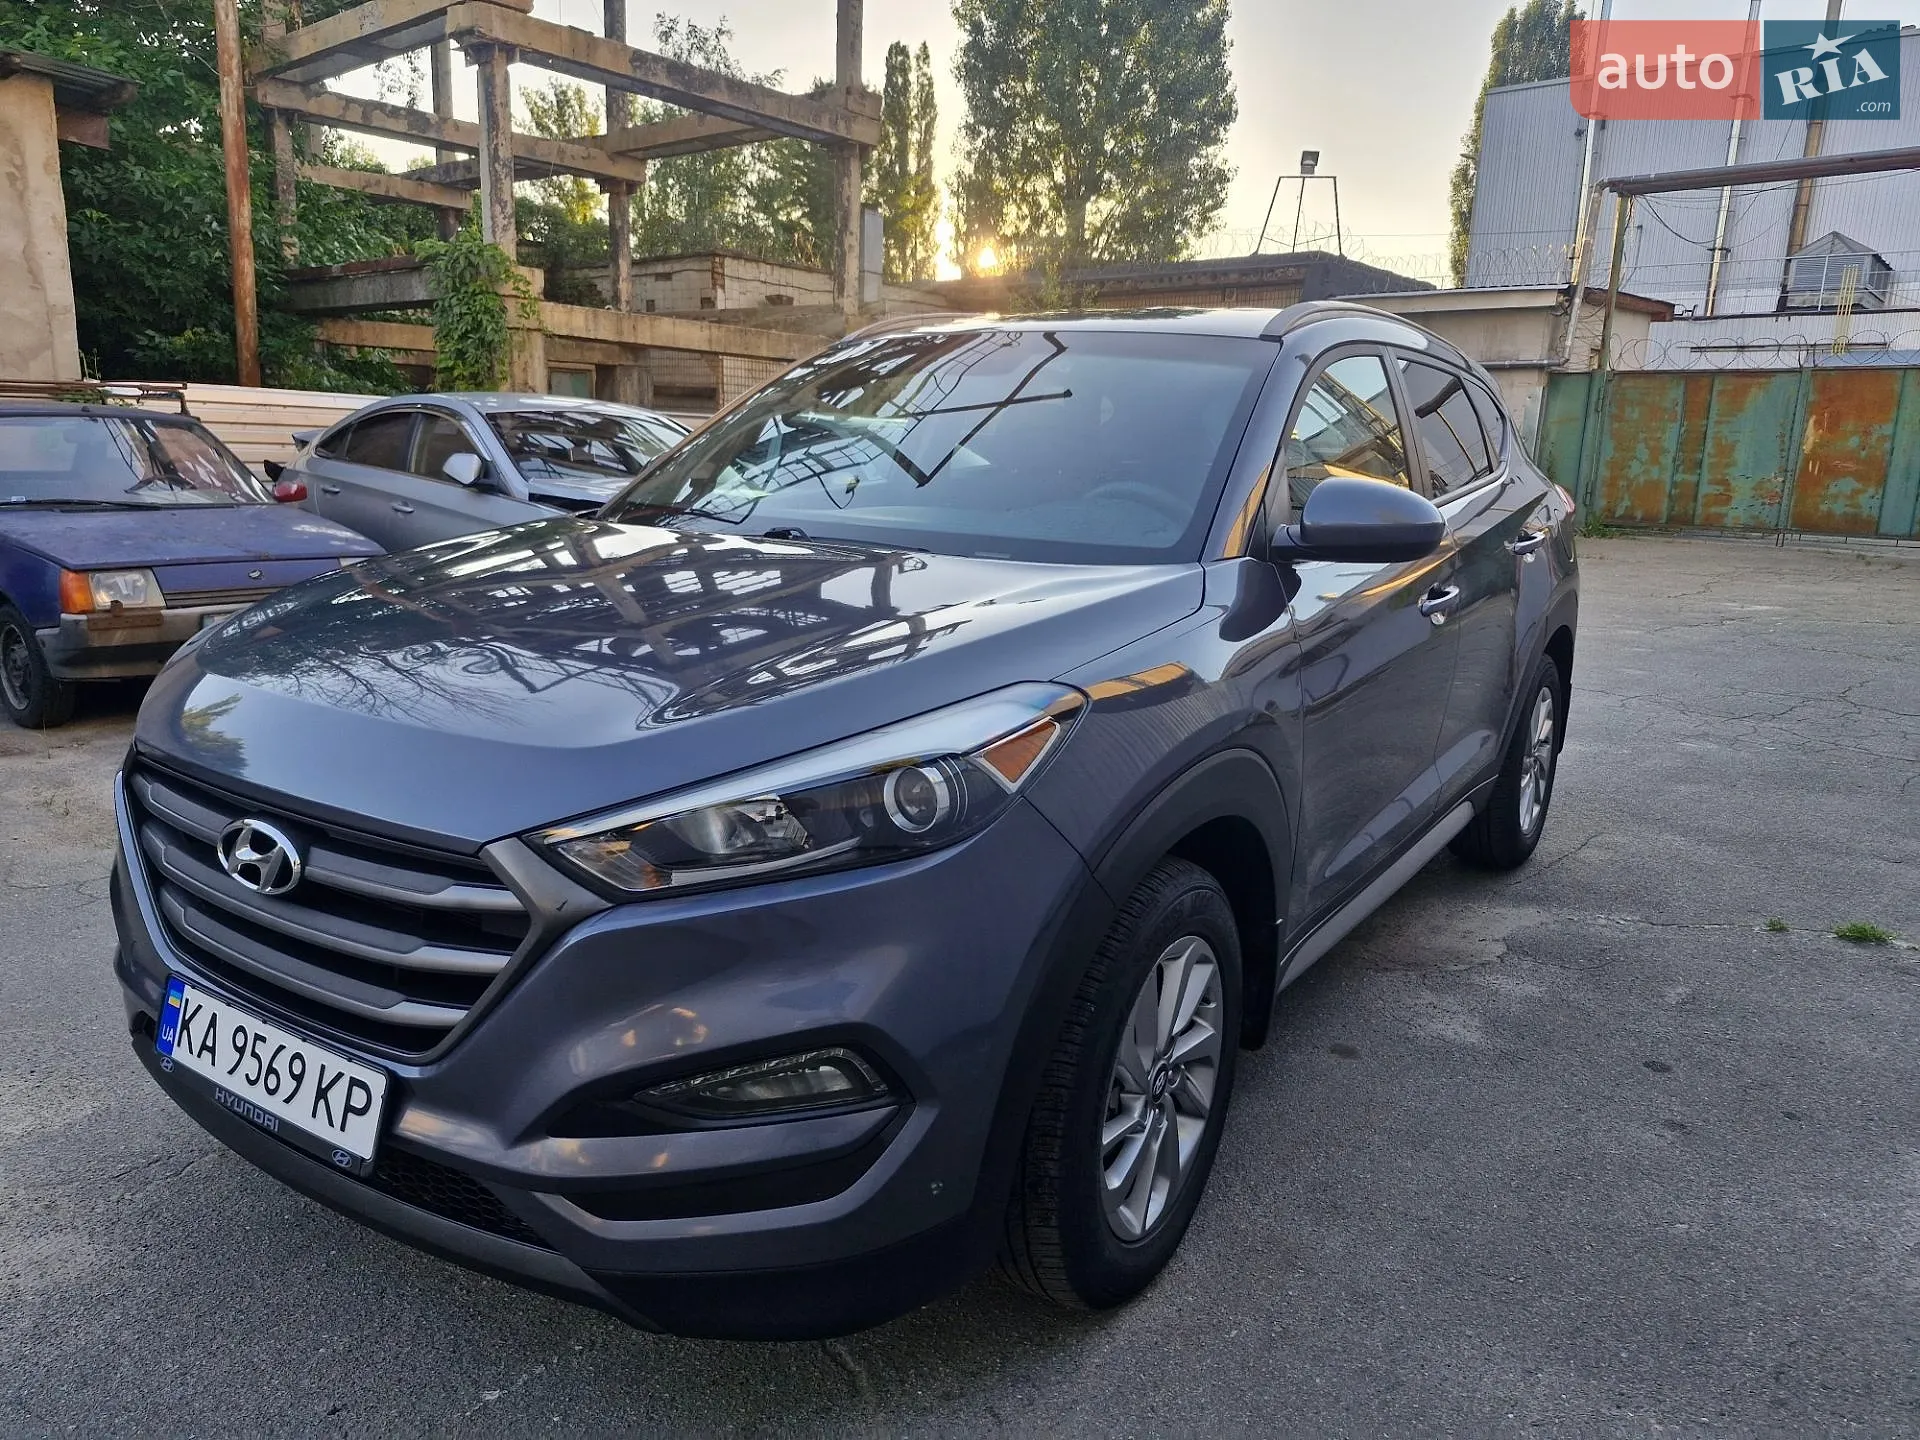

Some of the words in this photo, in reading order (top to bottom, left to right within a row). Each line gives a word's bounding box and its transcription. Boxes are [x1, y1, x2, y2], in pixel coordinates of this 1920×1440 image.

[161, 1025, 174, 1044] UA
[177, 998, 218, 1067] KA
[227, 1024, 307, 1104] 9569
[311, 1064, 373, 1132] KP
[215, 1087, 280, 1132] HYUNDAI
